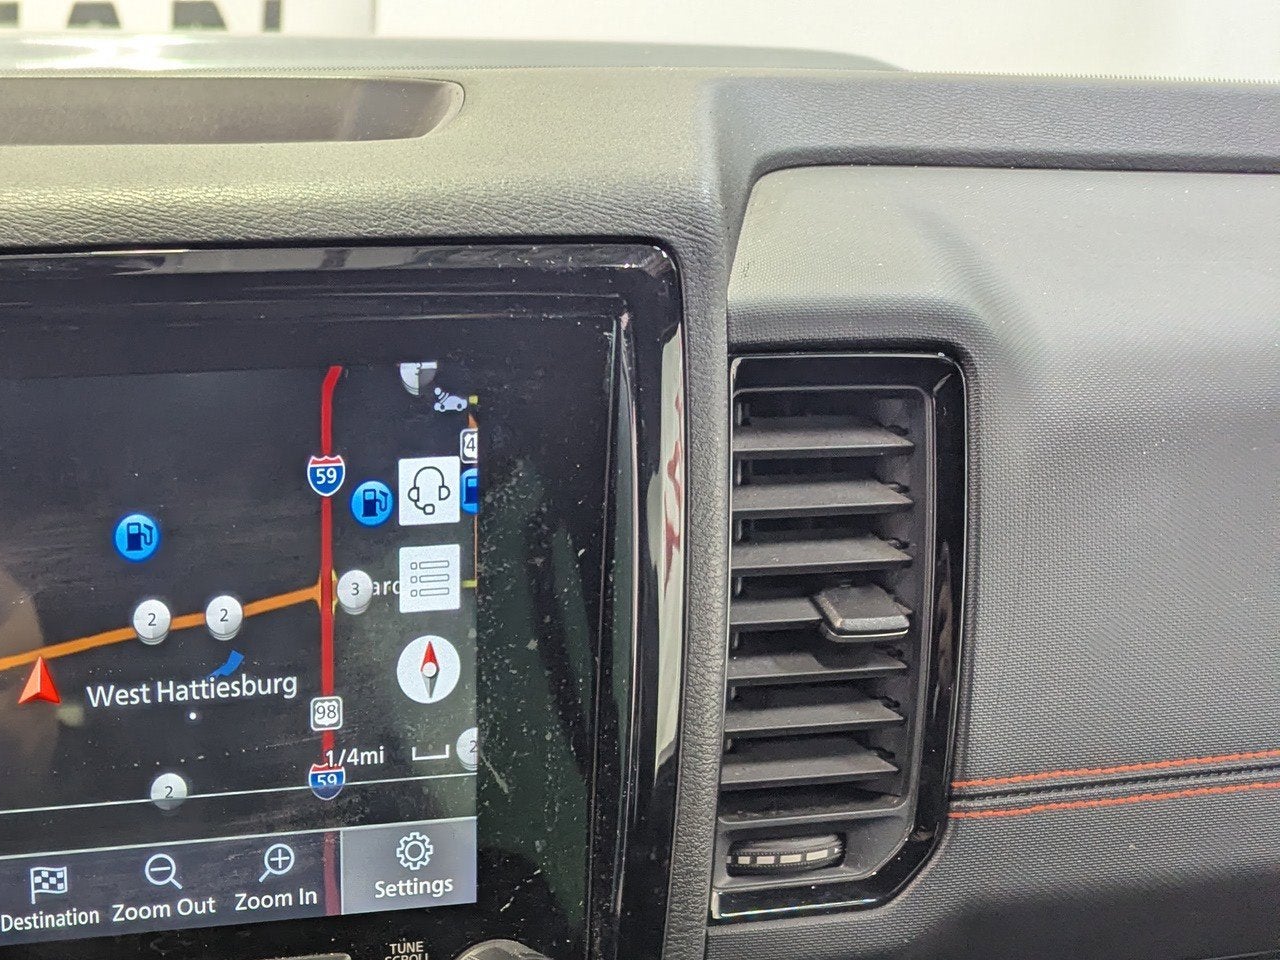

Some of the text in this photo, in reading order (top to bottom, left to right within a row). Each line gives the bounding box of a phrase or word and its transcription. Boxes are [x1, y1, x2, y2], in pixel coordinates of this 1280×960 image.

[315, 467, 337, 484] 59
[350, 582, 360, 596] 3
[147, 612, 157, 627] 2
[219, 608, 229, 623] 2
[86, 673, 298, 708] West Hattiesburg
[316, 704, 337, 720] 98
[325, 745, 385, 769] 1/4mi
[164, 785, 174, 799] 2
[374, 876, 454, 900] Settings
[235, 887, 318, 911] Zoom In
[112, 897, 216, 923] Zoom Out
[0, 907, 100, 933] Destination
[389, 941, 424, 955] TUNE
